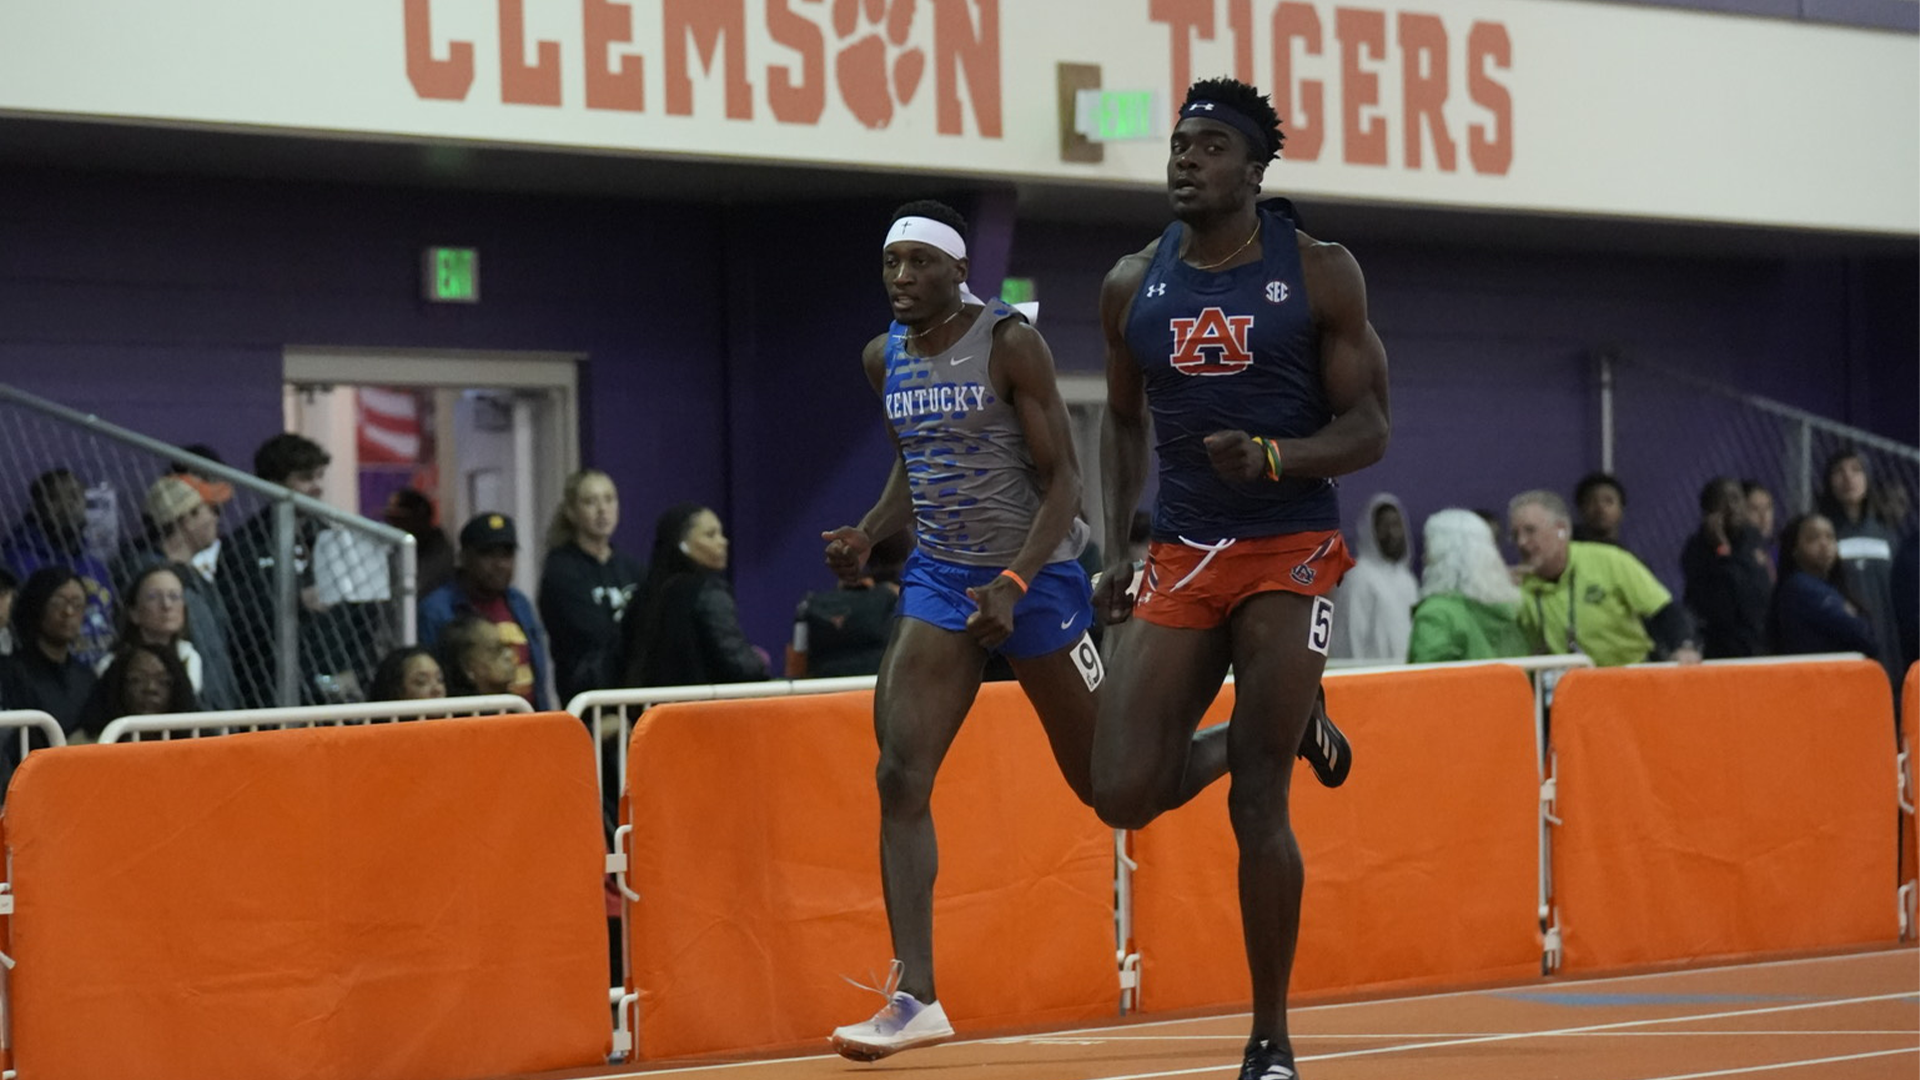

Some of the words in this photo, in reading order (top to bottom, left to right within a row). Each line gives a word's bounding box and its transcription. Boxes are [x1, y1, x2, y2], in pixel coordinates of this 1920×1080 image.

[1146, 0, 1514, 176] TIGERS
[1265, 281, 1289, 302] SEC
[886, 386, 985, 419] KENTUCKY
[1313, 601, 1333, 650] 5
[1079, 642, 1100, 684] 9
